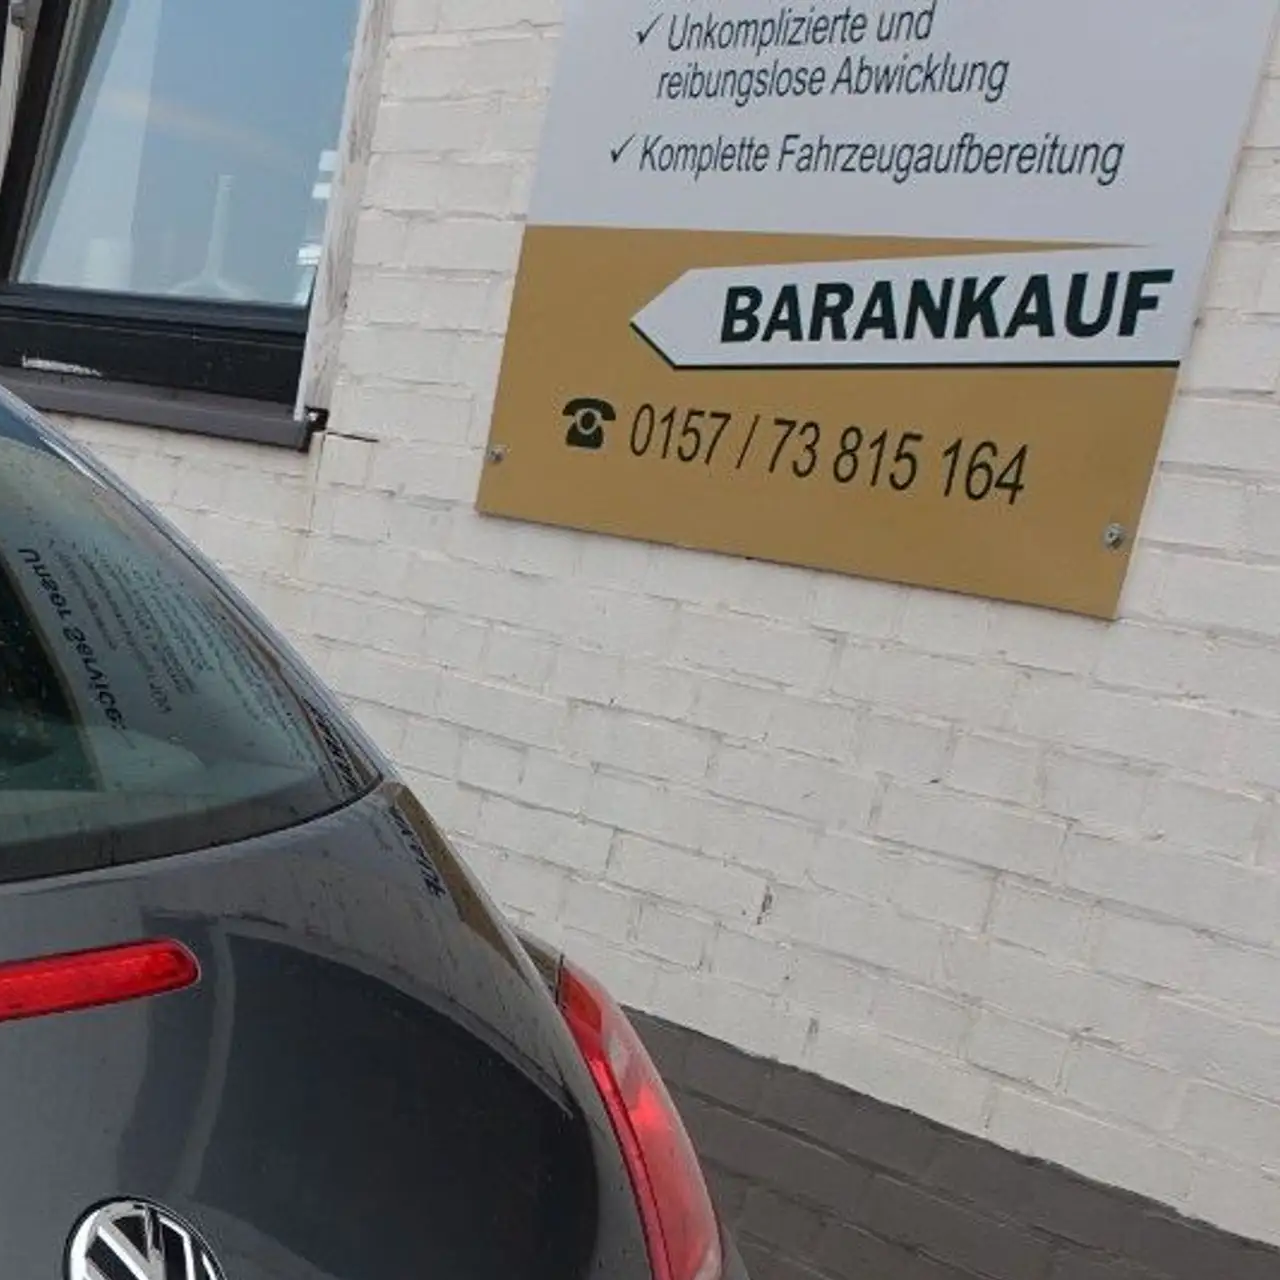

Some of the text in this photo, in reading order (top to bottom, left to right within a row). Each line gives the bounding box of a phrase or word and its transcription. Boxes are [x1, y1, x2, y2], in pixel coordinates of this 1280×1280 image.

[667, 1, 935, 56] Unkomplizierte und
[656, 51, 1010, 107] reibungslose Abwicklung
[639, 132, 1125, 187] Komplette Fahrzeugaufbereitung
[720, 268, 1174, 343] BARANKAUF
[630, 402, 732, 466] 0157
[768, 417, 822, 480] 73
[832, 424, 924, 492] 815
[942, 437, 1029, 505] 164
